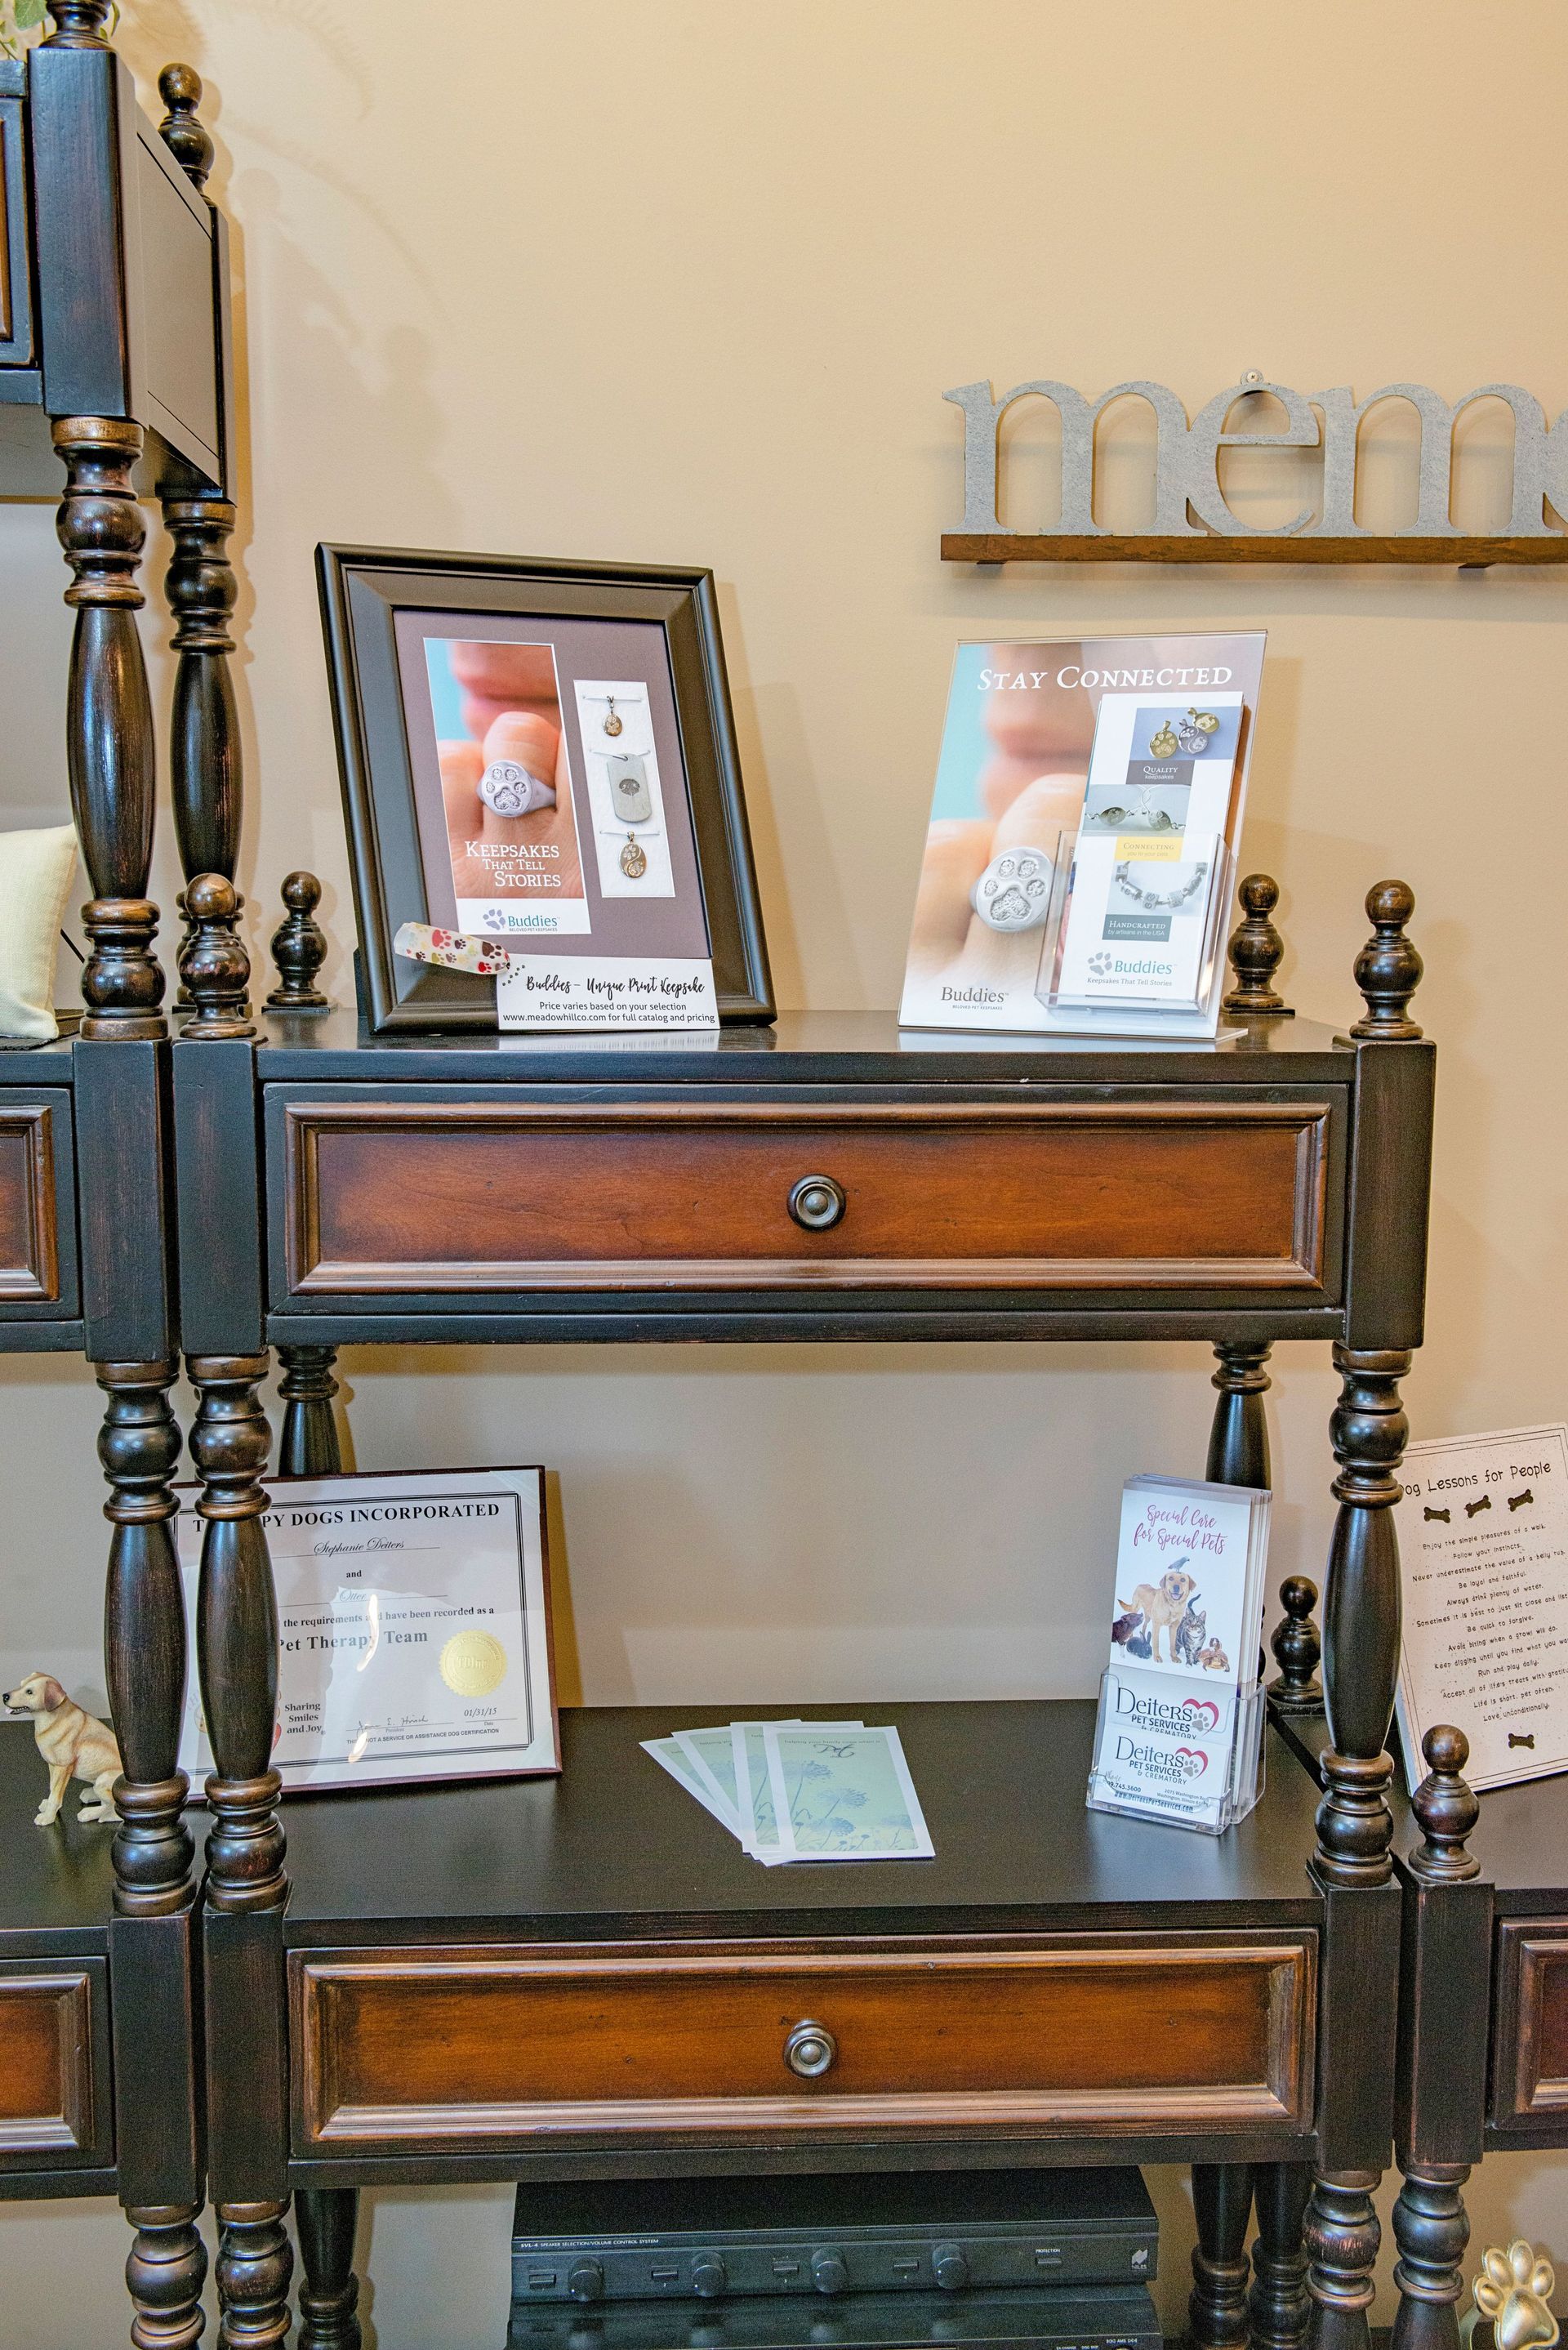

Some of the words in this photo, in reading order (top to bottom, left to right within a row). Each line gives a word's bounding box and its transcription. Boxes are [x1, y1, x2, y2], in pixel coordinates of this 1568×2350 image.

[941, 379, 1568, 537] mem
[977, 668, 1048, 690] STAY
[1056, 666, 1232, 689] CONNECTED
[1143, 765, 1178, 775] QUALITY
[464, 841, 559, 858] KEEPSAKES
[1123, 842, 1174, 850] CONNECTING
[482, 858, 514, 870] THAT
[516, 858, 546, 870] TELL
[494, 871, 562, 887] STORIES
[508, 915, 558, 927] Buddies
[1109, 921, 1166, 930] HANDCRAFTED
[1115, 960, 1173, 974] Buddies
[526, 974, 572, 994] Buddies
[586, 978, 625, 1001] Unique
[628, 976, 657, 993] Print
[660, 976, 705, 998] Keepsake
[941, 987, 1004, 1002] Buddies
[539, 1001, 561, 1010] Price
[590, 1002, 614, 1010] based
[629, 1004, 647, 1012] your
[649, 1002, 687, 1010] selection
[503, 1013, 607, 1021] www.meadowhillco.com
[638, 1014, 668, 1023] catalog
[687, 1014, 715, 1023] pricing
[1401, 1483, 1421, 1496] og
[1428, 1474, 1478, 1492] Lessons
[1485, 1469, 1503, 1483] for
[1509, 1461, 1552, 1479] People
[292, 1511, 343, 1527] DOGS
[350, 1503, 500, 1523] INCORPORATED
[1147, 1505, 1189, 1527] Special
[1191, 1509, 1218, 1528] Care
[1134, 1523, 1155, 1546] for
[1157, 1528, 1200, 1550] Special
[1201, 1532, 1228, 1554] Pets
[1459, 1536, 1477, 1544] simple
[1481, 1530, 1511, 1541] pleasures
[314, 1541, 364, 1557] Stephanie
[366, 1536, 404, 1550] Deiters
[1453, 1551, 1472, 1559] Follow
[1476, 1549, 1490, 1557] your
[345, 1570, 362, 1578] and
[1412, 1574, 1432, 1582] Never
[1436, 1566, 1481, 1578] underestimate
[1536, 1552, 1551, 1560] belly
[1470, 1579, 1485, 1587] loyal
[1446, 1598, 1468, 1606] Always
[1490, 1590, 1510, 1599] plenty
[283, 1619, 298, 1627] the
[301, 1615, 363, 1627] requirements
[365, 1612, 382, 1621] ad
[385, 1612, 408, 1620] have
[409, 1610, 430, 1618] been
[434, 1608, 474, 1617] recorded
[1416, 1616, 1450, 1627] Sometimes
[1470, 1609, 1485, 1617] best
[1498, 1605, 1511, 1613] just
[1525, 1599, 1542, 1607] close
[1480, 1623, 1495, 1631] quick
[307, 1635, 375, 1650] Therap
[383, 1630, 428, 1644] Team
[1448, 1643, 1466, 1652] Avoid
[1469, 1639, 1486, 1648] biting
[1516, 1631, 1533, 1639] growl
[1454, 1657, 1477, 1666] digging
[1496, 1651, 1508, 1659] you
[1442, 1690, 1465, 1698] Accept
[284, 1702, 320, 1712] Sharing
[1473, 1700, 1488, 1708] Life
[288, 1713, 318, 1723] Smiles
[463, 1706, 497, 1717] 01/31/15
[1483, 1713, 1499, 1722] Love
[287, 1725, 305, 1734] and
[305, 1724, 322, 1734] Joy
[1131, 1714, 1147, 1724] PET
[1148, 1717, 1191, 1732] SERVICES
[1129, 1759, 1143, 1769] PET
[1145, 1764, 1182, 1777] SERVICES
[1145, 1771, 1187, 1786] CREMATORY
[1107, 1781, 1142, 1792] 9.745.3600
[1175, 1791, 1199, 1799] Washington
